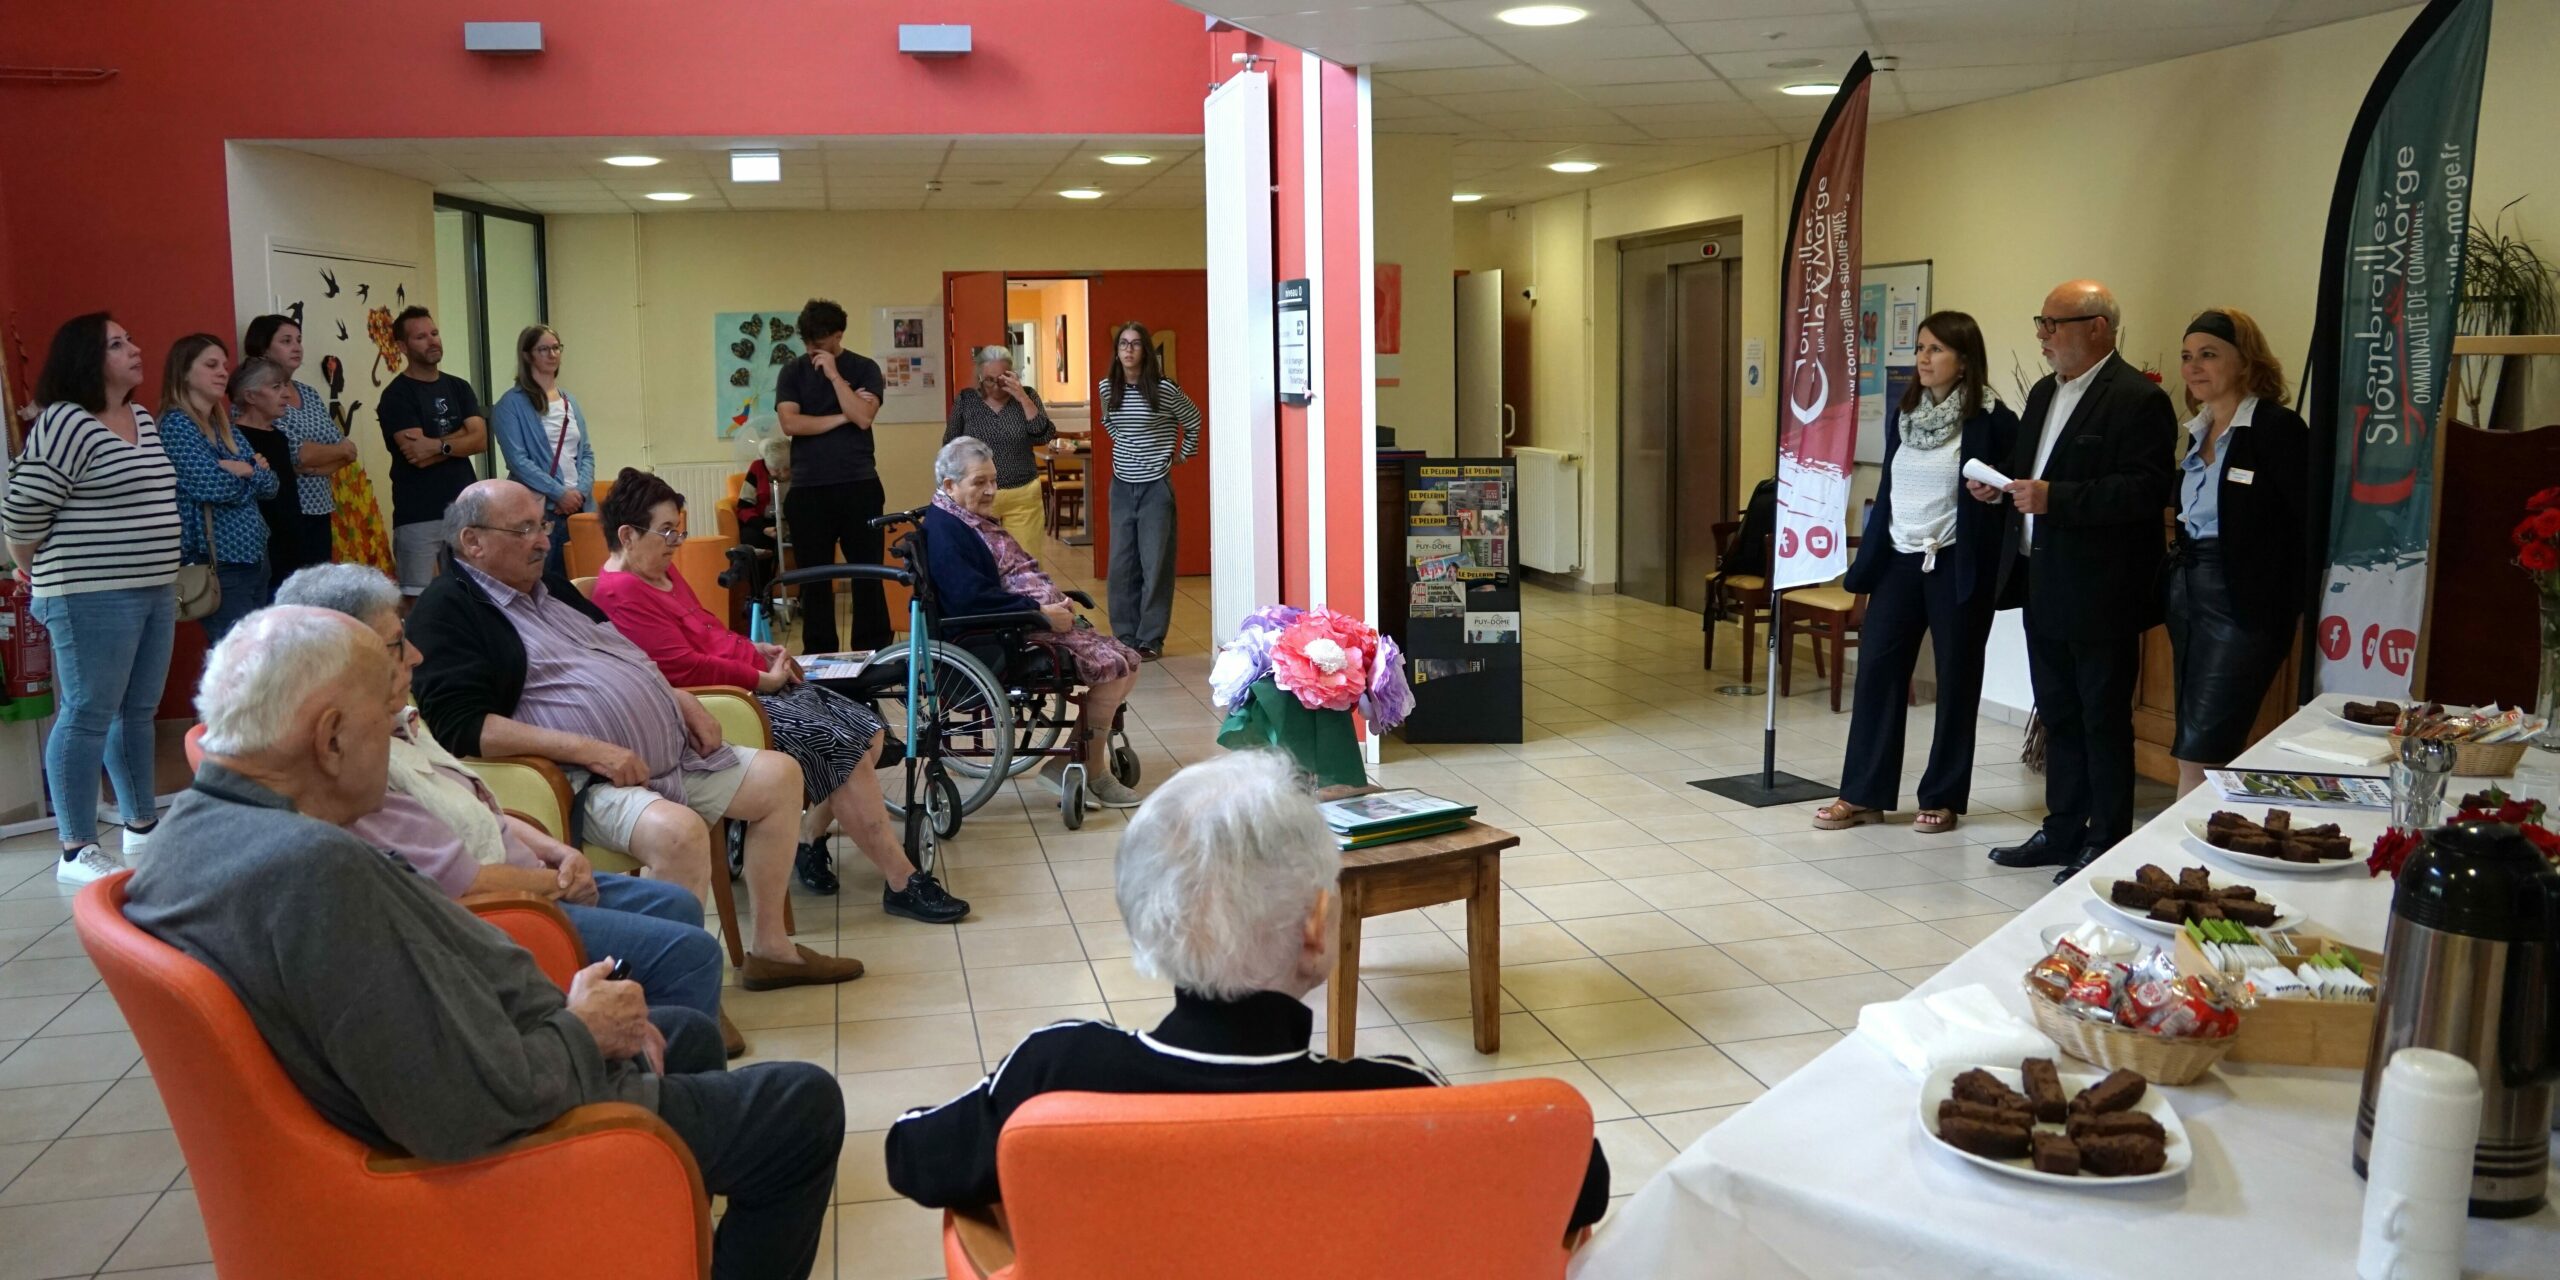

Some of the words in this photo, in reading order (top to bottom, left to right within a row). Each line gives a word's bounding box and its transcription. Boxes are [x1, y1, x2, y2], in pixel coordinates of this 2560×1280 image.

[1812, 176, 1830, 266] Morge
[2385, 145, 2420, 276] Morge
[2407, 200, 2426, 285] COMMUNES
[2407, 289, 2428, 309] DE
